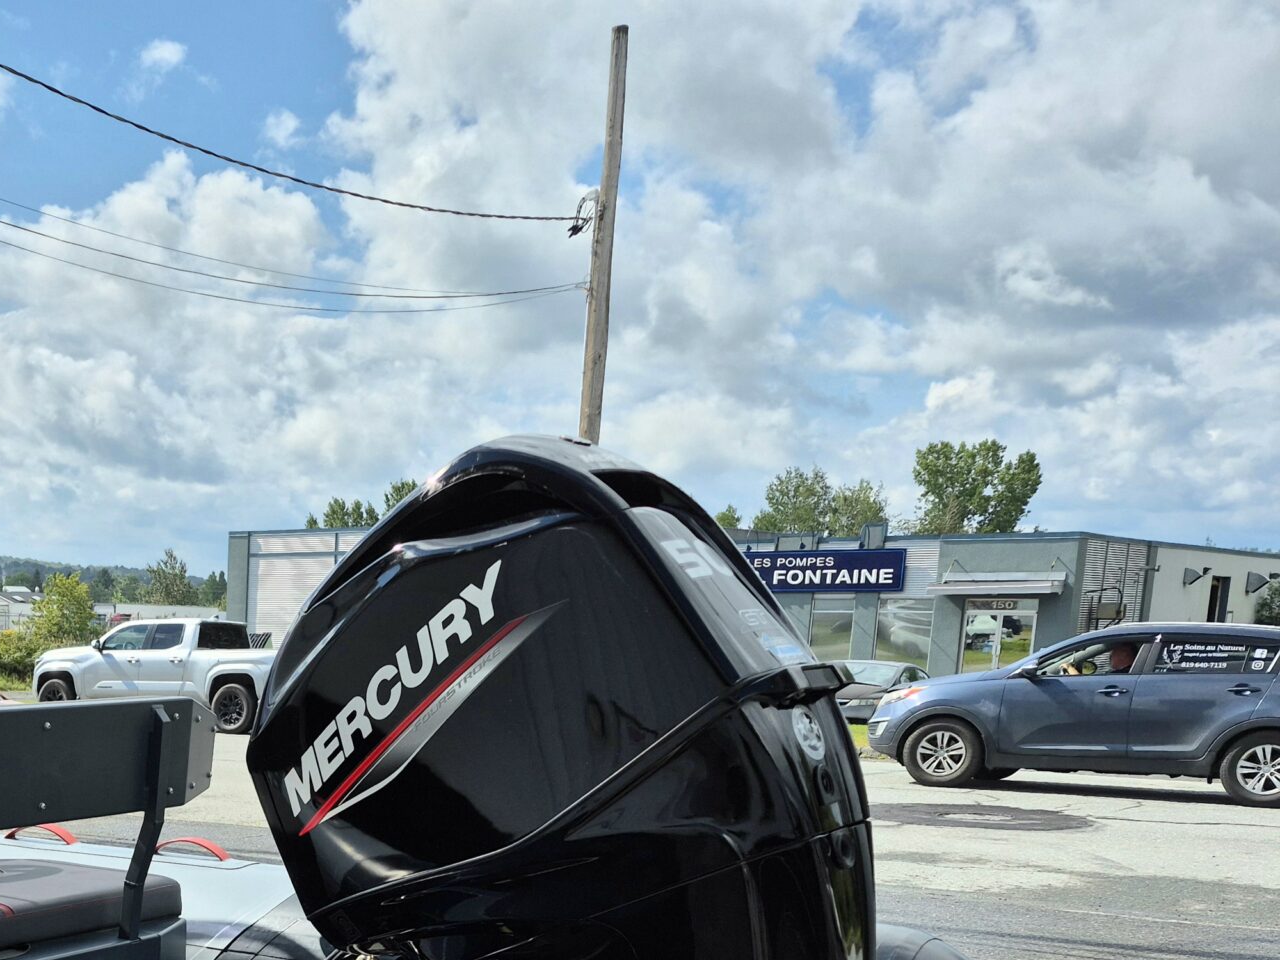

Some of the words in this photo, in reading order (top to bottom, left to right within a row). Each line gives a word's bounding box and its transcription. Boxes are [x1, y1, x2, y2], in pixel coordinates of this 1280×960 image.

[776, 556, 835, 568] POMPES
[772, 568, 895, 585] FONTAINE
[991, 601, 1014, 609] 150
[1184, 643, 1206, 651] Soins
[1217, 644, 1245, 652] Naturel
[284, 559, 502, 817] MERCURY
[412, 647, 502, 733] FOURSTROKE
